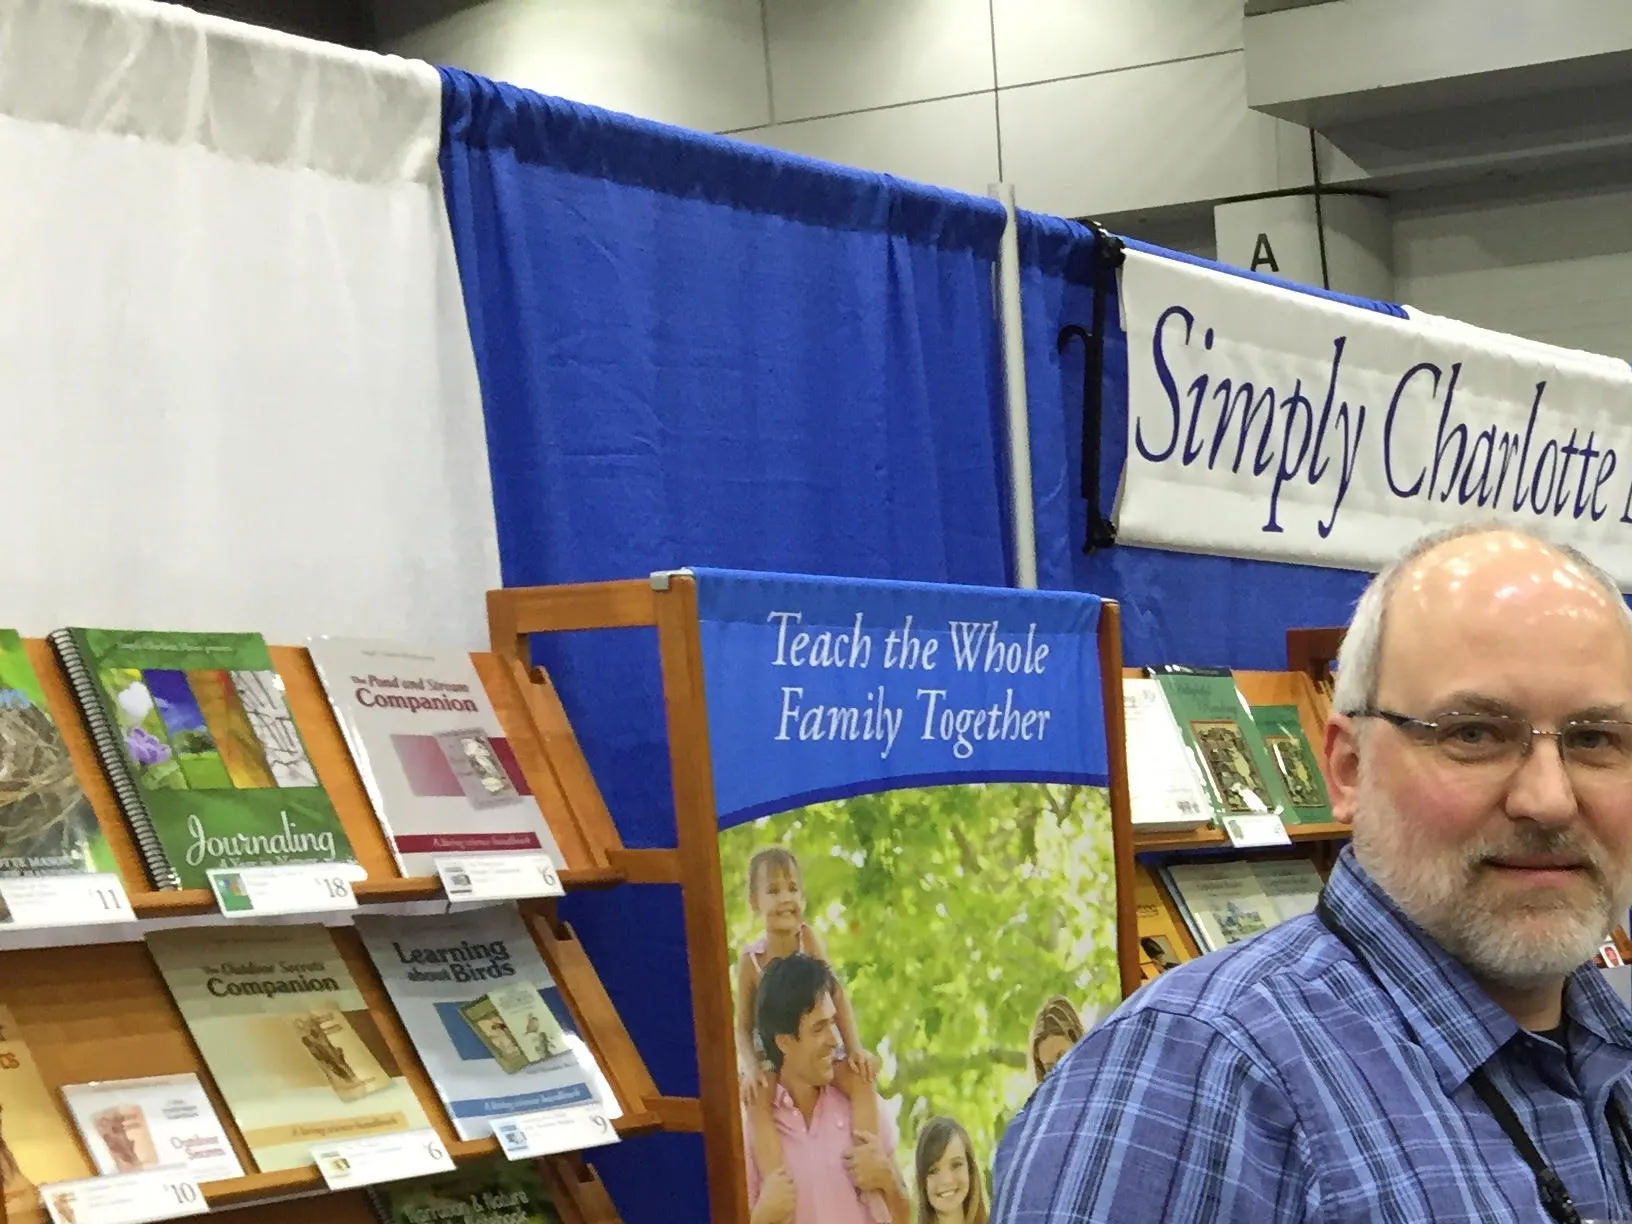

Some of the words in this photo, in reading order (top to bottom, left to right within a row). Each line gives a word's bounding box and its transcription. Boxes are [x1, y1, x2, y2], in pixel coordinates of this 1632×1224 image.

[1251, 233, 1279, 272] A
[1136, 306, 1365, 537] Simply
[1384, 362, 1616, 523] Charlotte
[767, 611, 871, 668] Teach
[884, 615, 939, 670] the
[949, 620, 1049, 674] Whole
[355, 687, 479, 713] Companion
[774, 685, 903, 759] Family
[916, 688, 1051, 759] Together
[185, 810, 337, 866] Journaling
[392, 940, 511, 964] Learning
[450, 960, 517, 983] Birds
[206, 975, 340, 998] Companion
